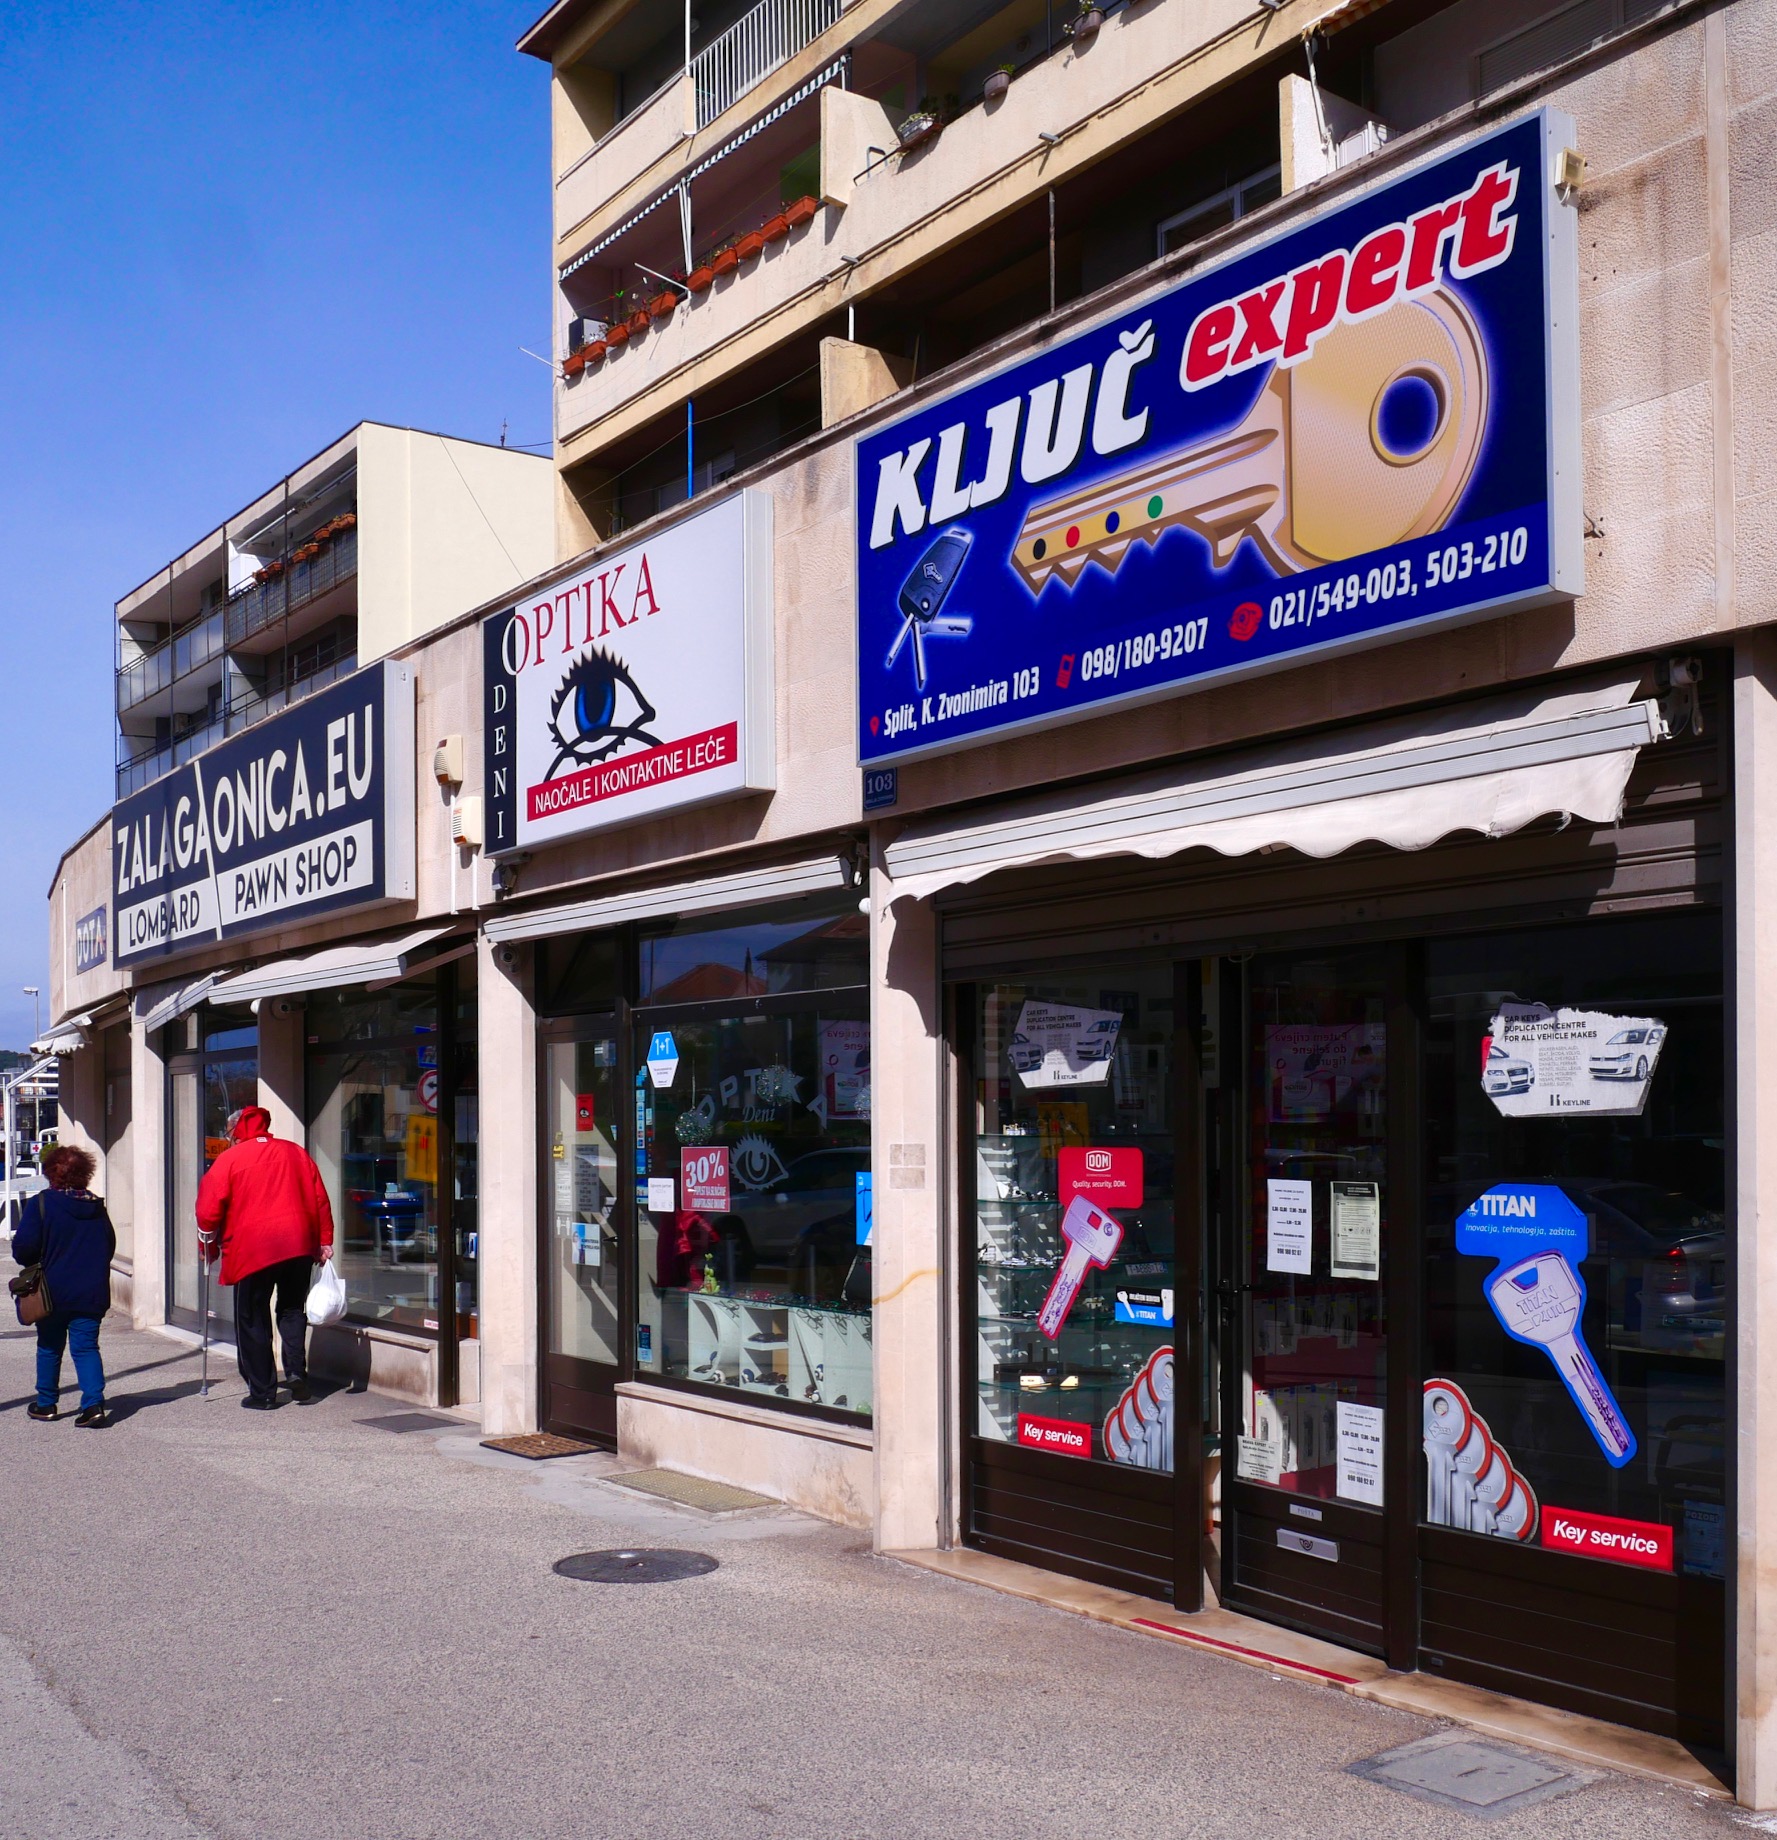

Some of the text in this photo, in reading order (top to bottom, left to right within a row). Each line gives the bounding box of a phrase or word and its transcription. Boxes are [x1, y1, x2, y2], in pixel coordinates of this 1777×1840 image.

[869, 163, 1518, 549] KLJUČ expert
[1269, 526, 1528, 630] 021/549-003, 503-210
[502, 552, 661, 676] OPTIKA
[1081, 618, 1209, 682] 098/180-9207
[883, 666, 1040, 739] Split, K. Zvonimira 103
[493, 684, 507, 839] DENI
[535, 735, 726, 814] NAOČALE I KONTAKTNE LEĆE
[117, 703, 373, 896] ZALAGAONICA.EU
[867, 773, 893, 795] 103
[235, 834, 358, 915] PAWN SHOP
[129, 889, 200, 948] LOMBARD
[1504, 1021, 1586, 1033] DUPLICATION CENTRE
[1521, 1014, 1540, 1022] KEYS
[655, 1037, 670, 1056] 1+1
[1537, 1032, 1568, 1041] VEHICLE
[1570, 1030, 1597, 1039] MAKES
[742, 1102, 775, 1123] Deni
[686, 1150, 724, 1187] 30%
[1089, 1154, 1109, 1168] DOM
[1072, 1180, 1091, 1188] Quality,
[1092, 1180, 1112, 1188] security,
[1480, 1194, 1536, 1217] TITAN
[1465, 1224, 1577, 1236] Inovacija, tehnologija, zaštita.
[1516, 1285, 1558, 1315] TITAN
[1024, 1423, 1083, 1446] Key service
[1553, 1520, 1658, 1554] Key service
